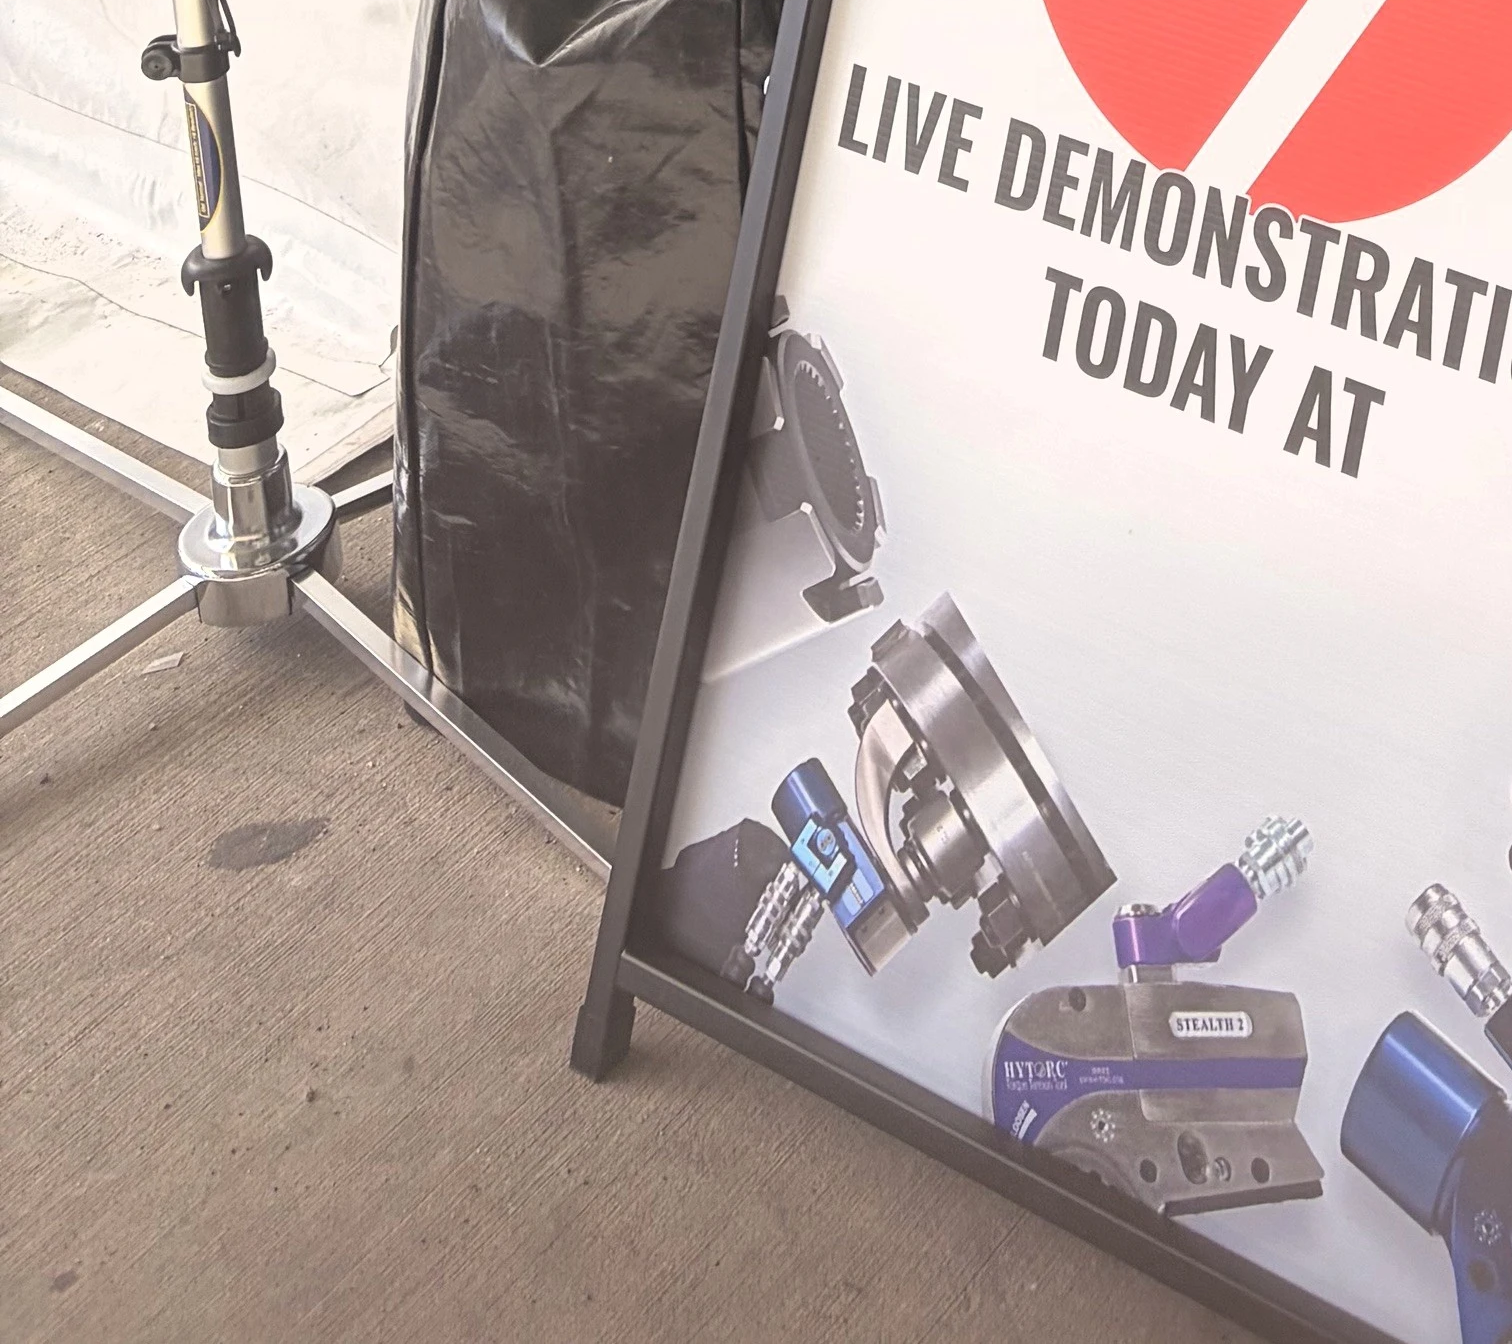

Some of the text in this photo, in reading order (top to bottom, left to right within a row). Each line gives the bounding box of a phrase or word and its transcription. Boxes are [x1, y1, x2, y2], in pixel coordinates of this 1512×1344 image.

[837, 63, 985, 192] LIVE
[1041, 265, 1387, 479] TODAY AT
[1176, 1018, 1245, 1032] STEALTH 2
